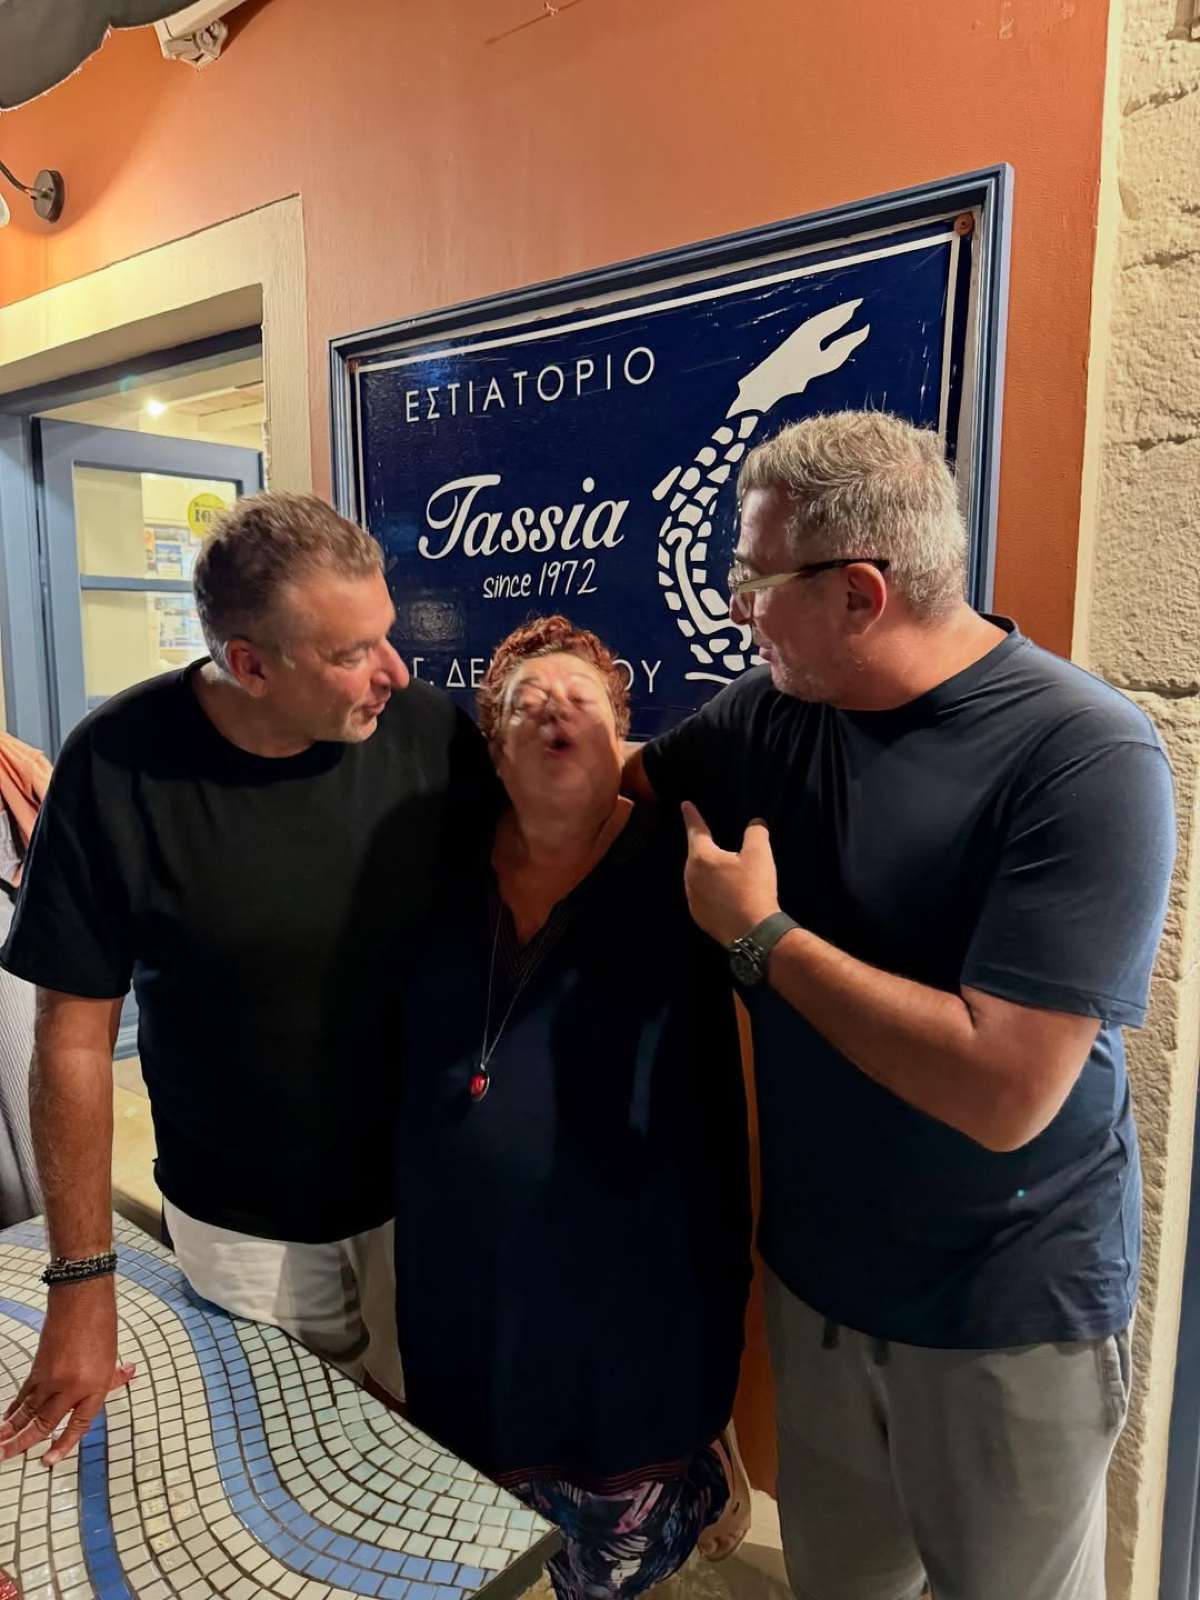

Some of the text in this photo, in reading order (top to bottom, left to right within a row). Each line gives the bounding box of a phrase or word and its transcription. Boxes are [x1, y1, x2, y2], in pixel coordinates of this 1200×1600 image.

[405, 346, 656, 423] ΕΣΤΙΑΤΟΡΙΟ
[418, 473, 630, 560] Tassia
[482, 558, 598, 599] since 1972
